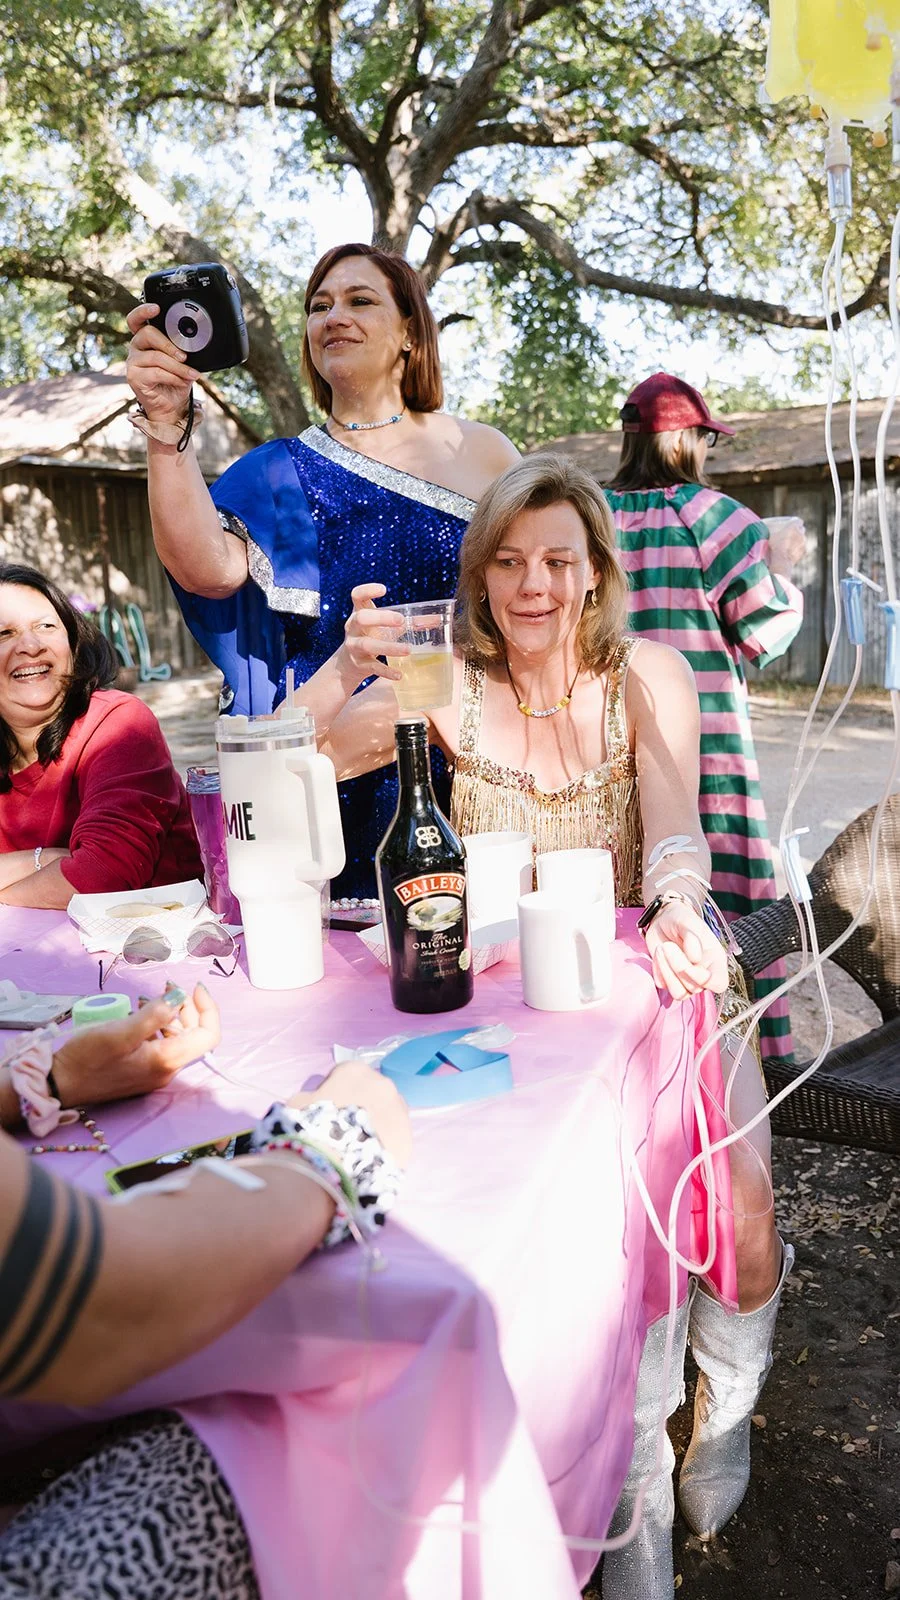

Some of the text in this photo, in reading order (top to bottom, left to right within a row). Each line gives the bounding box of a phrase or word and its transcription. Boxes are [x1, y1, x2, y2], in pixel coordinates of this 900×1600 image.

[222, 801, 256, 841] MIE
[400, 877, 464, 900] BAILEYS
[412, 936, 463, 950] ORIGINAL
[431, 934, 448, 943] The
